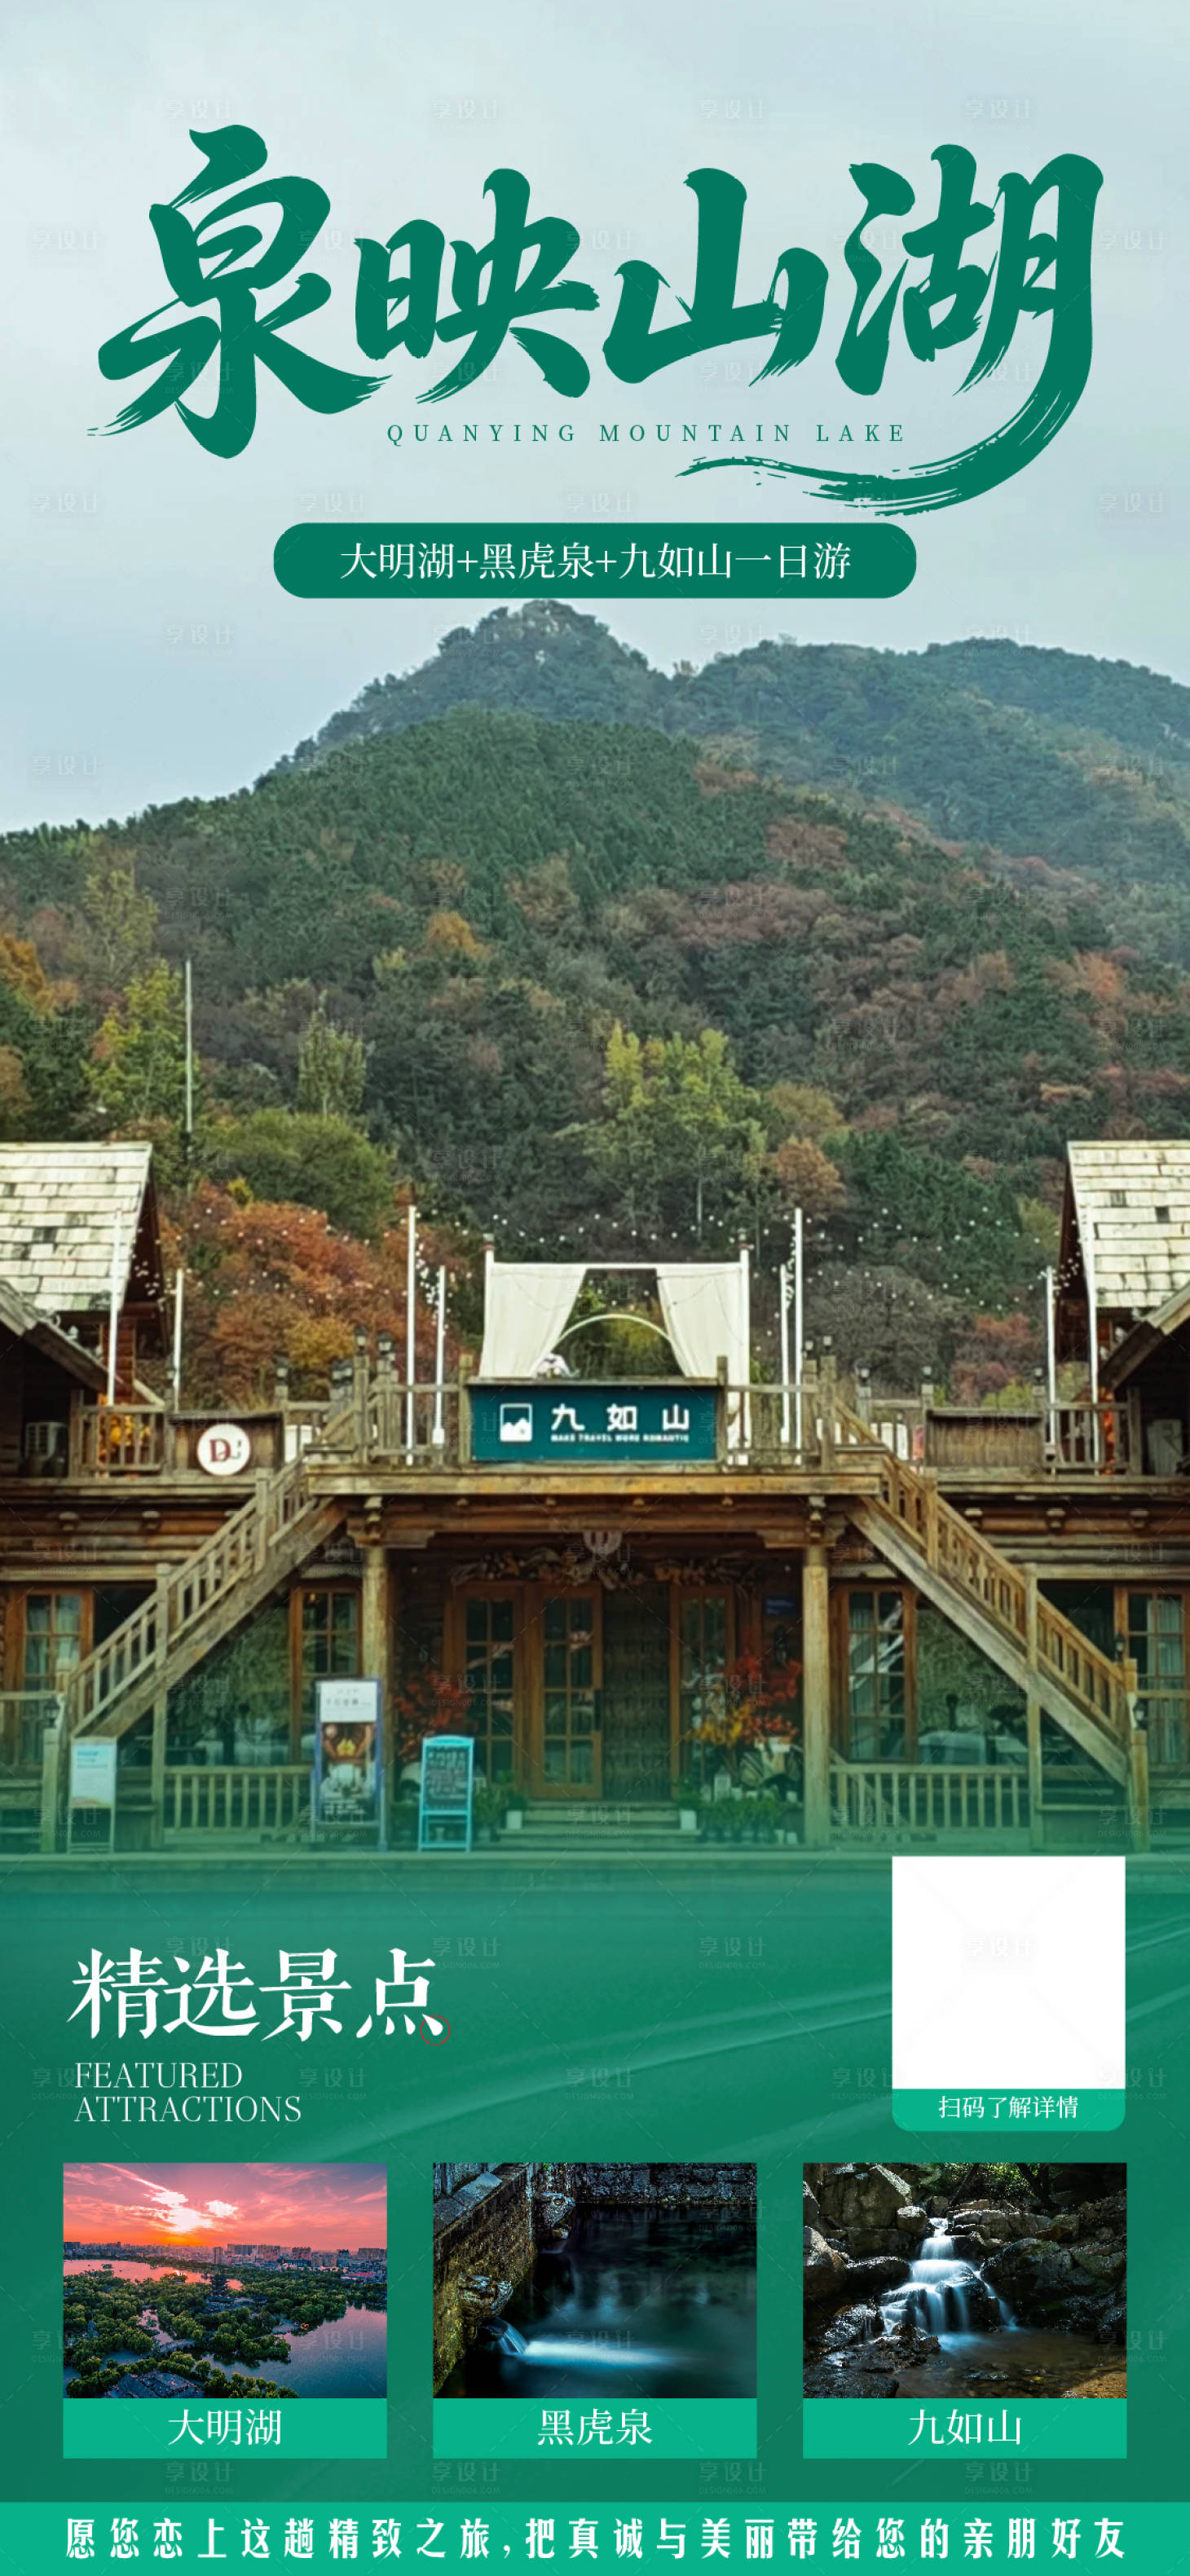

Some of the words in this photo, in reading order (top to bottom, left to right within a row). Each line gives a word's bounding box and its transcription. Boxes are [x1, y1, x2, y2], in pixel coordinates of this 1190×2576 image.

[87, 124, 1104, 517] 泉映山湖
[387, 424, 575, 447] QUANYING
[599, 424, 791, 443] MOUNTAIN
[815, 424, 905, 443] LAKE
[339, 541, 851, 580] 大明湖+黑虎泉+九如山一日游
[550, 1402, 690, 1432] 九如山
[578, 1433, 612, 1442] TRAVEL
[67, 1946, 444, 2042] 精选景点
[75, 2062, 242, 2089] FEATURED
[74, 2095, 302, 2123] ATTRACTIONS
[938, 2094, 1078, 2120] 扫码了解详情
[167, 2408, 282, 2446] 大明湖
[537, 2407, 653, 2446] 黑虎泉
[907, 2408, 1021, 2446] 九如山
